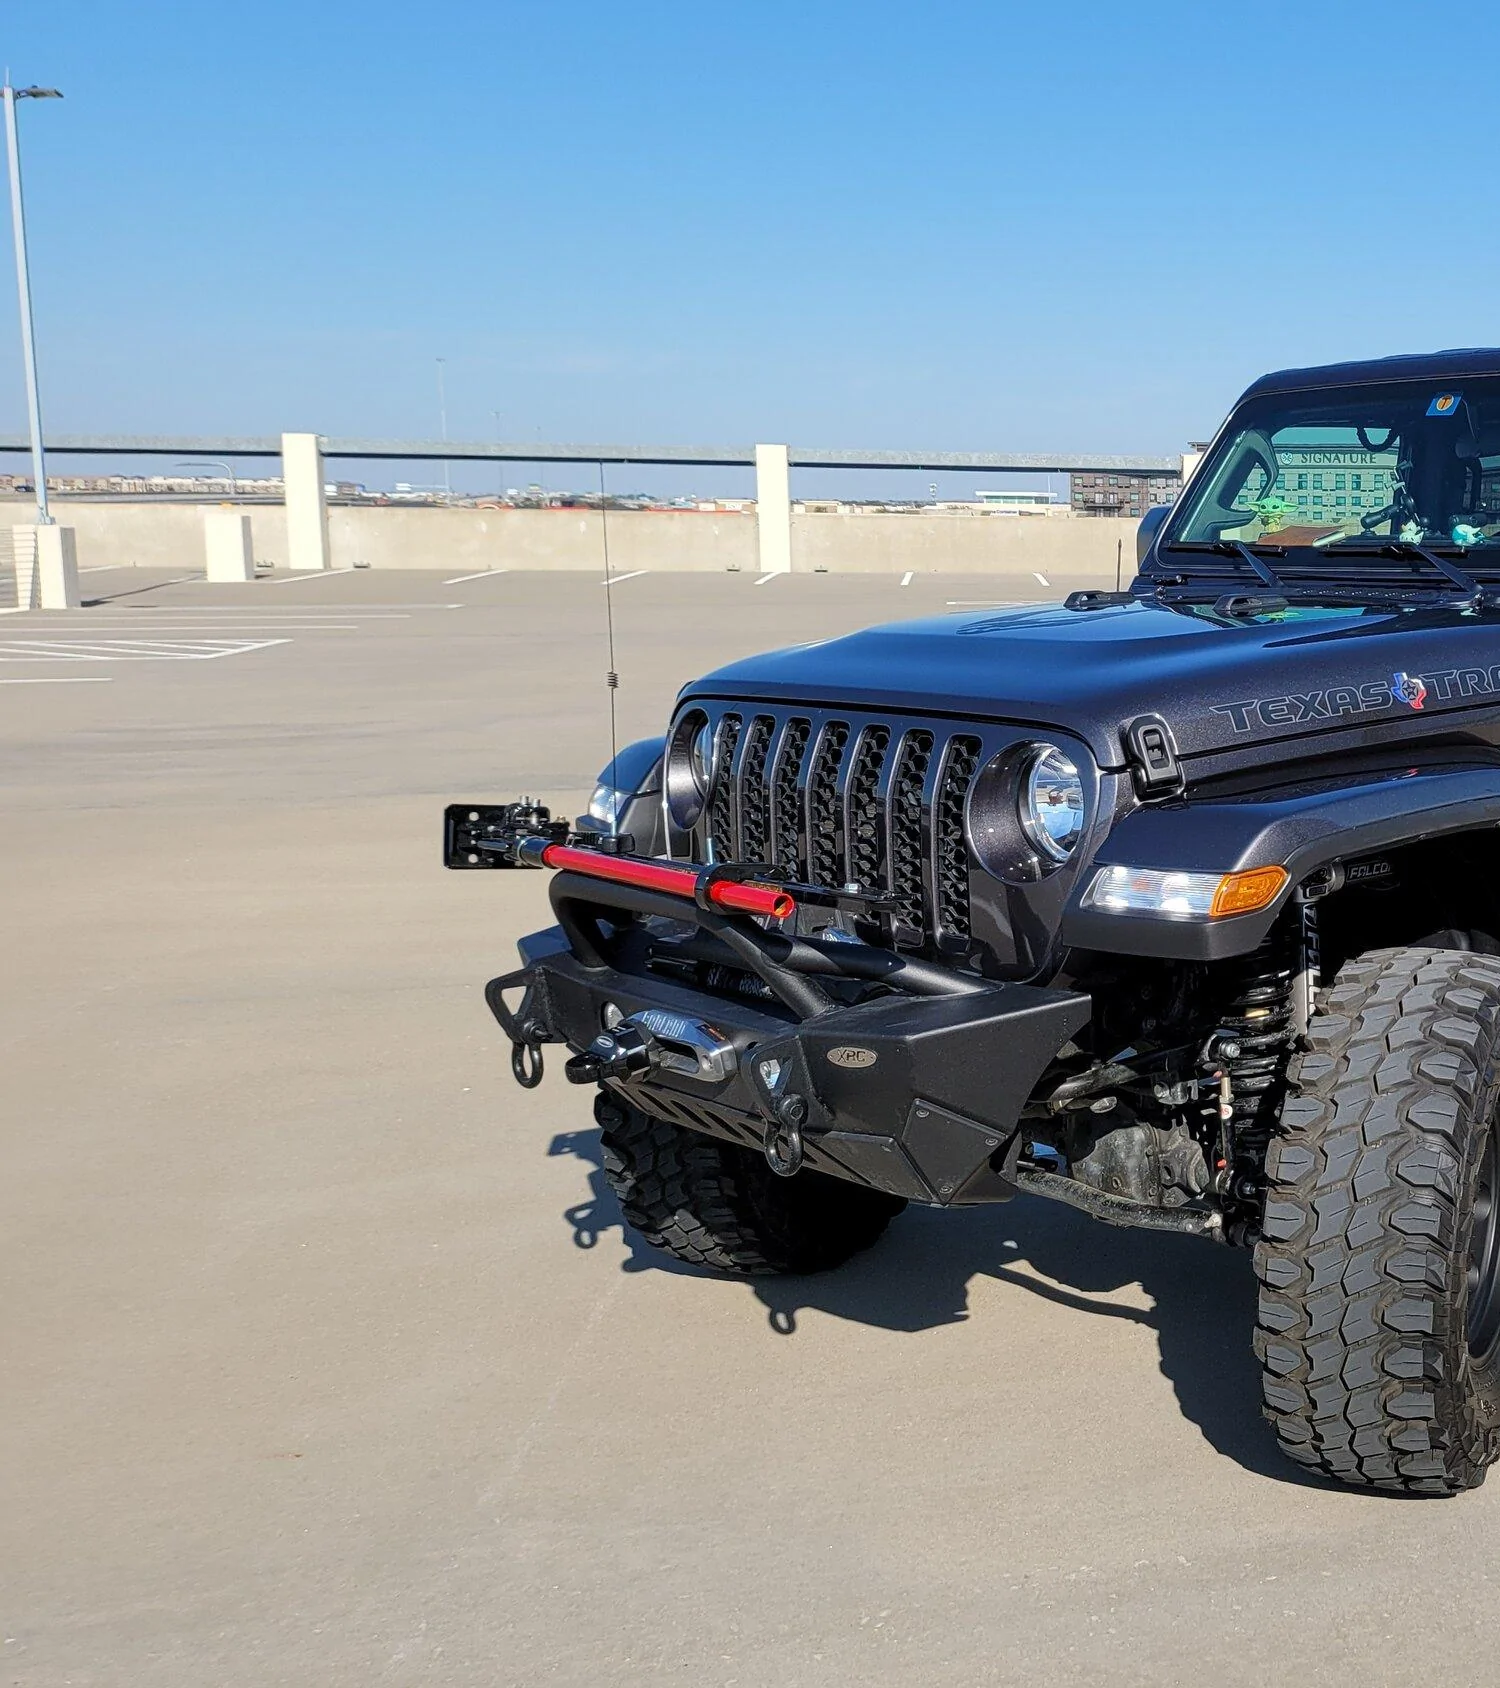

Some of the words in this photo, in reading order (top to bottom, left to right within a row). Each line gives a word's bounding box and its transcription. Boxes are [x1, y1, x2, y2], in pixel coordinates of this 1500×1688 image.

[1301, 453, 1377, 464] SIGNATURE
[1210, 681, 1394, 733] TEXAS
[837, 1049, 866, 1062] XRC
